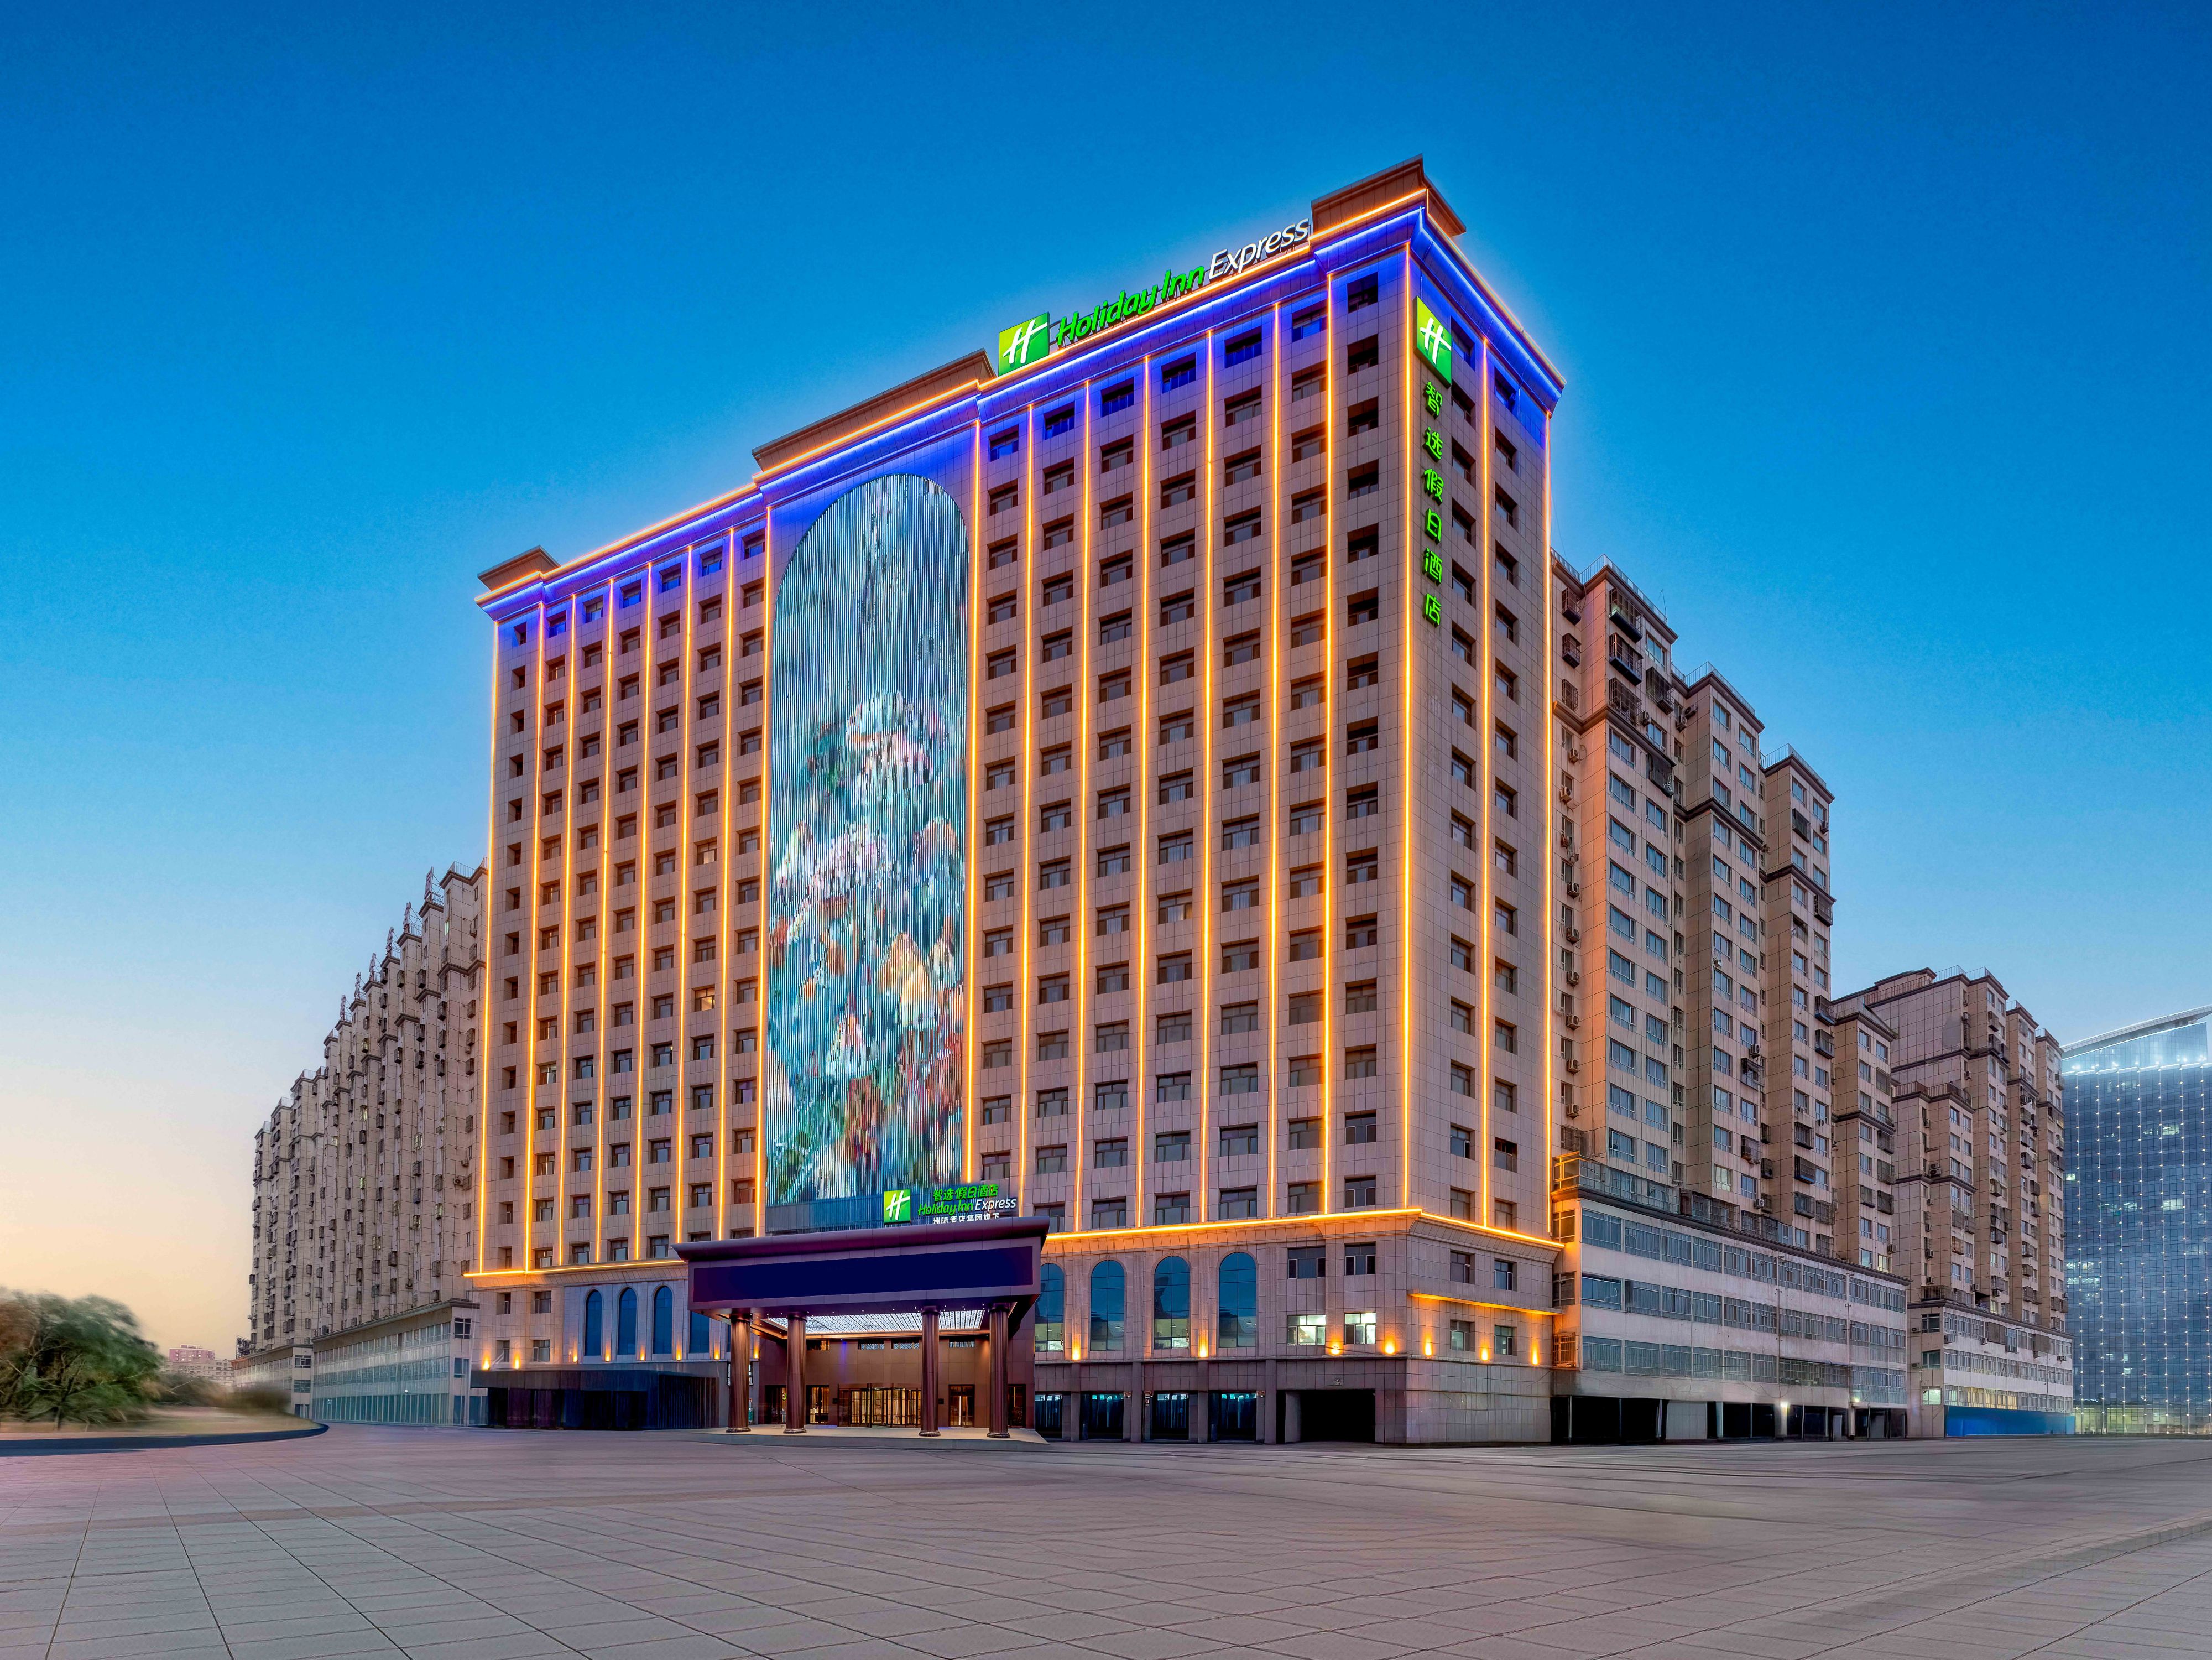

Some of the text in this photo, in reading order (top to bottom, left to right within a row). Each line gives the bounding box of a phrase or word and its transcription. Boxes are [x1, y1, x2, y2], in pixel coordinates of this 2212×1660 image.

[1056, 218, 1310, 345] Holiday Inn Express
[1423, 381, 1443, 625] 智选假日酒店
[933, 1184, 999, 1202] 智选假日酒店
[917, 1198, 1016, 1216] Holiday Inn Express
[933, 1213, 1000, 1225] 洲际酒店集团旗下
